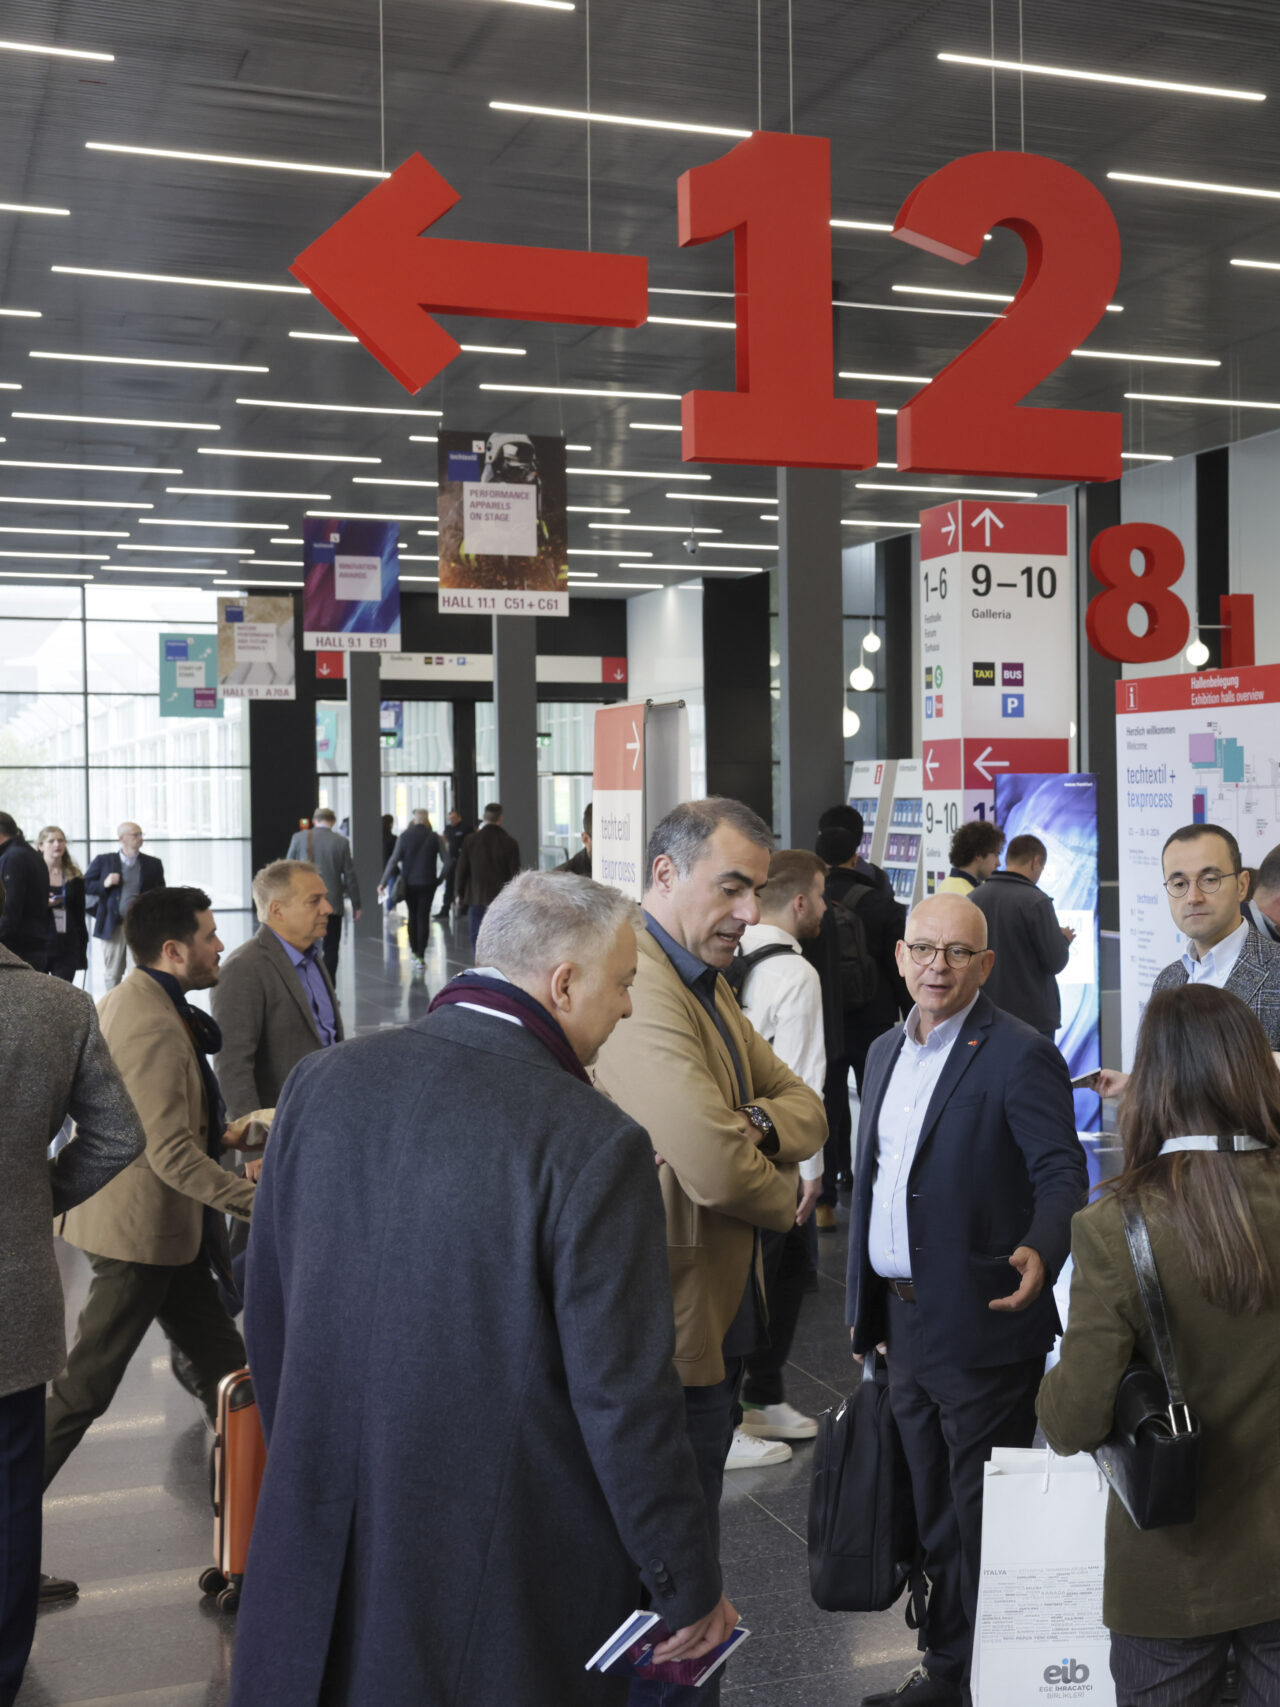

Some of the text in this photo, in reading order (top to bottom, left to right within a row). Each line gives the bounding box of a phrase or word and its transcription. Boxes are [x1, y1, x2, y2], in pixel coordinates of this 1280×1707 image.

[677, 130, 1123, 484] 12
[469, 490, 530, 500] PERFORMANCE
[469, 502, 512, 511] APPARELS
[470, 513, 510, 522] ON STAGE
[1085, 522, 1190, 664] 8
[442, 596, 559, 610] HALL 11.1 C51 + C61
[971, 608, 1012, 620] Galleria
[316, 637, 388, 648] HALL 9.1 E91
[974, 669, 994, 679] TAXI
[1003, 670, 1022, 680] BUS
[1190, 675, 1240, 690] Hallenbelegung
[223, 688, 244, 697] HALL
[1191, 690, 1264, 706] Exhibition halls overview
[1007, 697, 1019, 714] P
[1127, 763, 1167, 785] techtextil
[1127, 790, 1173, 813] texprocess
[601, 812, 630, 840] techtextil
[1043, 1657, 1090, 1684] eib
